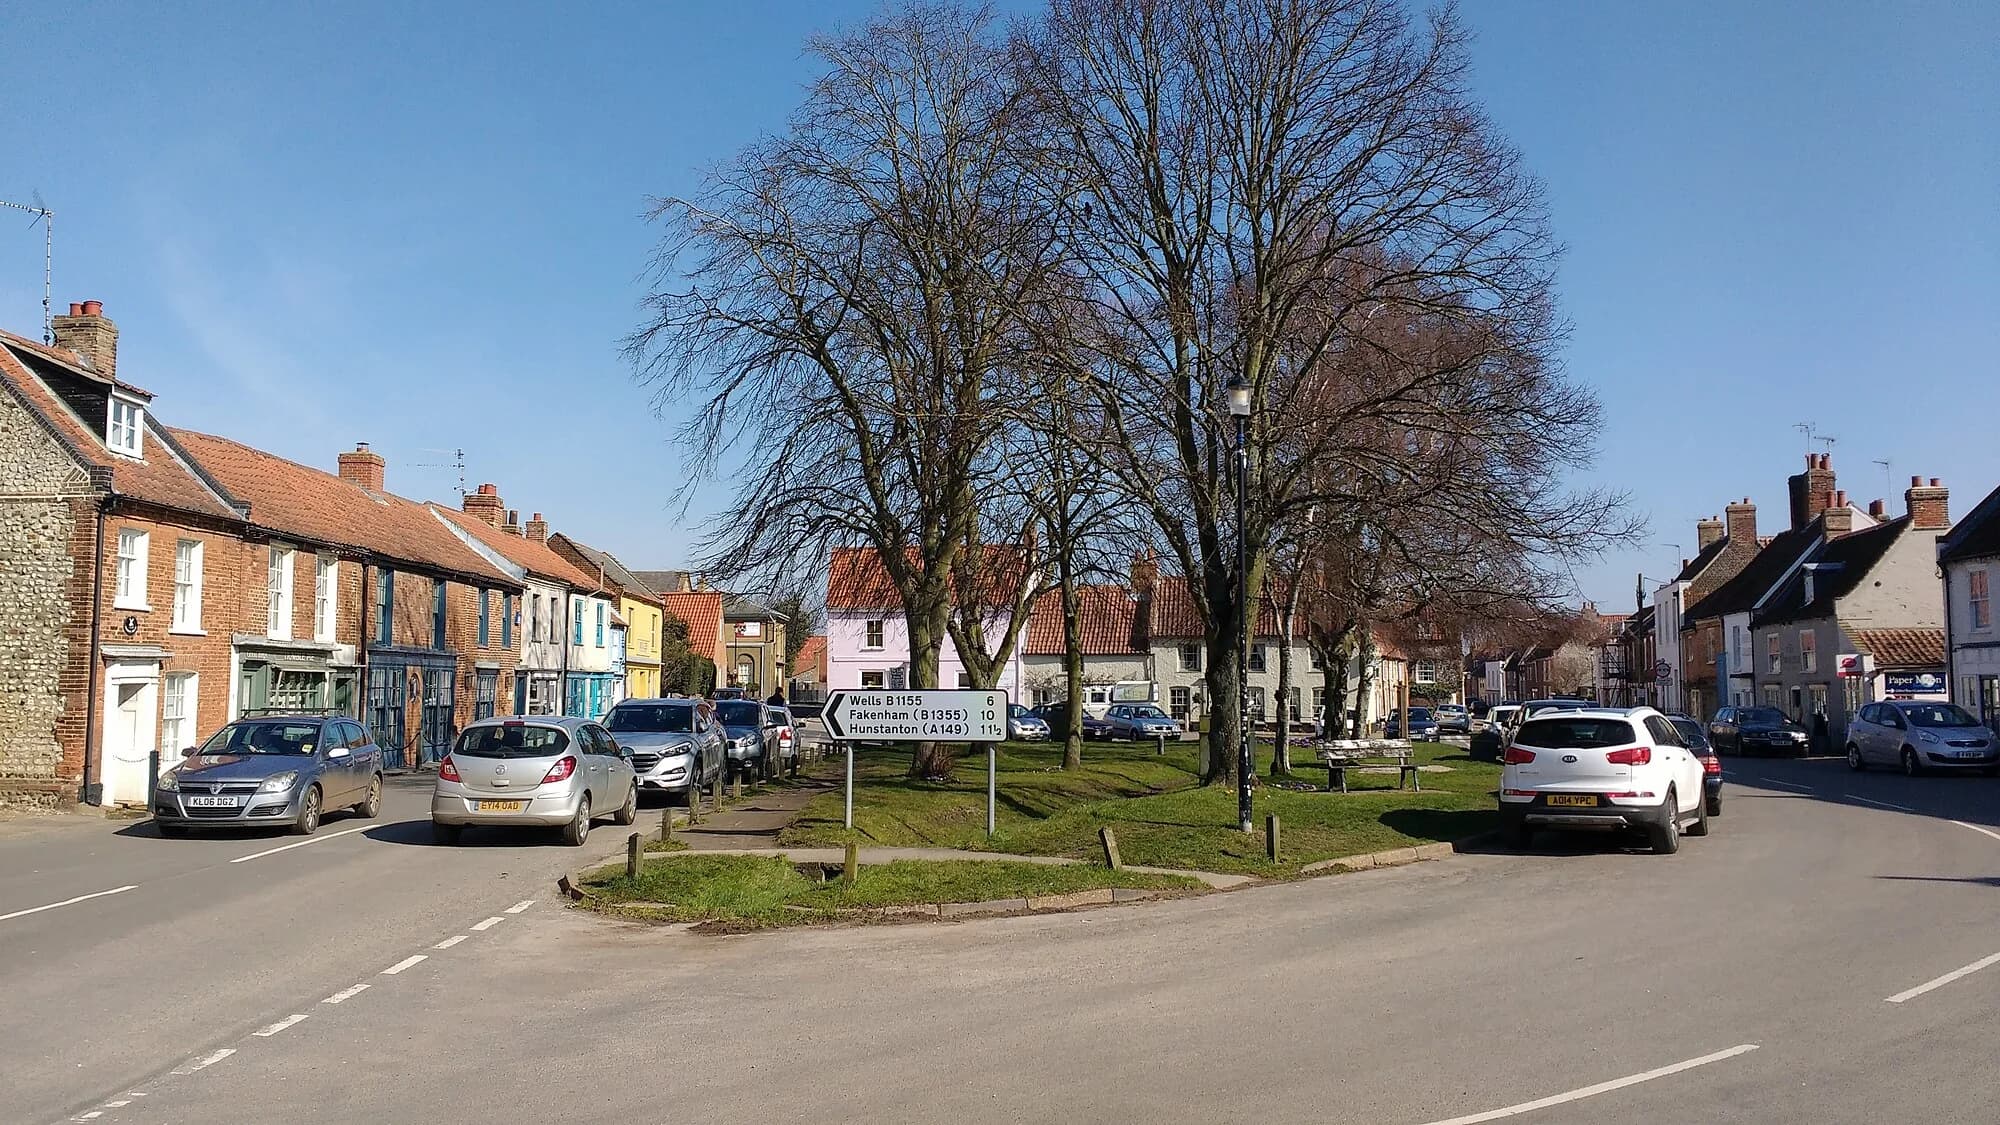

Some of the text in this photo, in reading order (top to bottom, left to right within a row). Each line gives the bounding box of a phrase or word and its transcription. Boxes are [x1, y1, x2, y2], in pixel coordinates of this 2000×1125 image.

[1889, 674, 1942, 686] Paper Mn
[849, 695, 994, 706] Wells B1155 6
[849, 708, 995, 721] Fakenham (B1355) 10
[849, 723, 918, 735] Hunstanton
[922, 722, 969, 736] (A149)
[193, 798, 234, 806] KL06 DGZ
[1575, 796, 1591, 805] YPC
